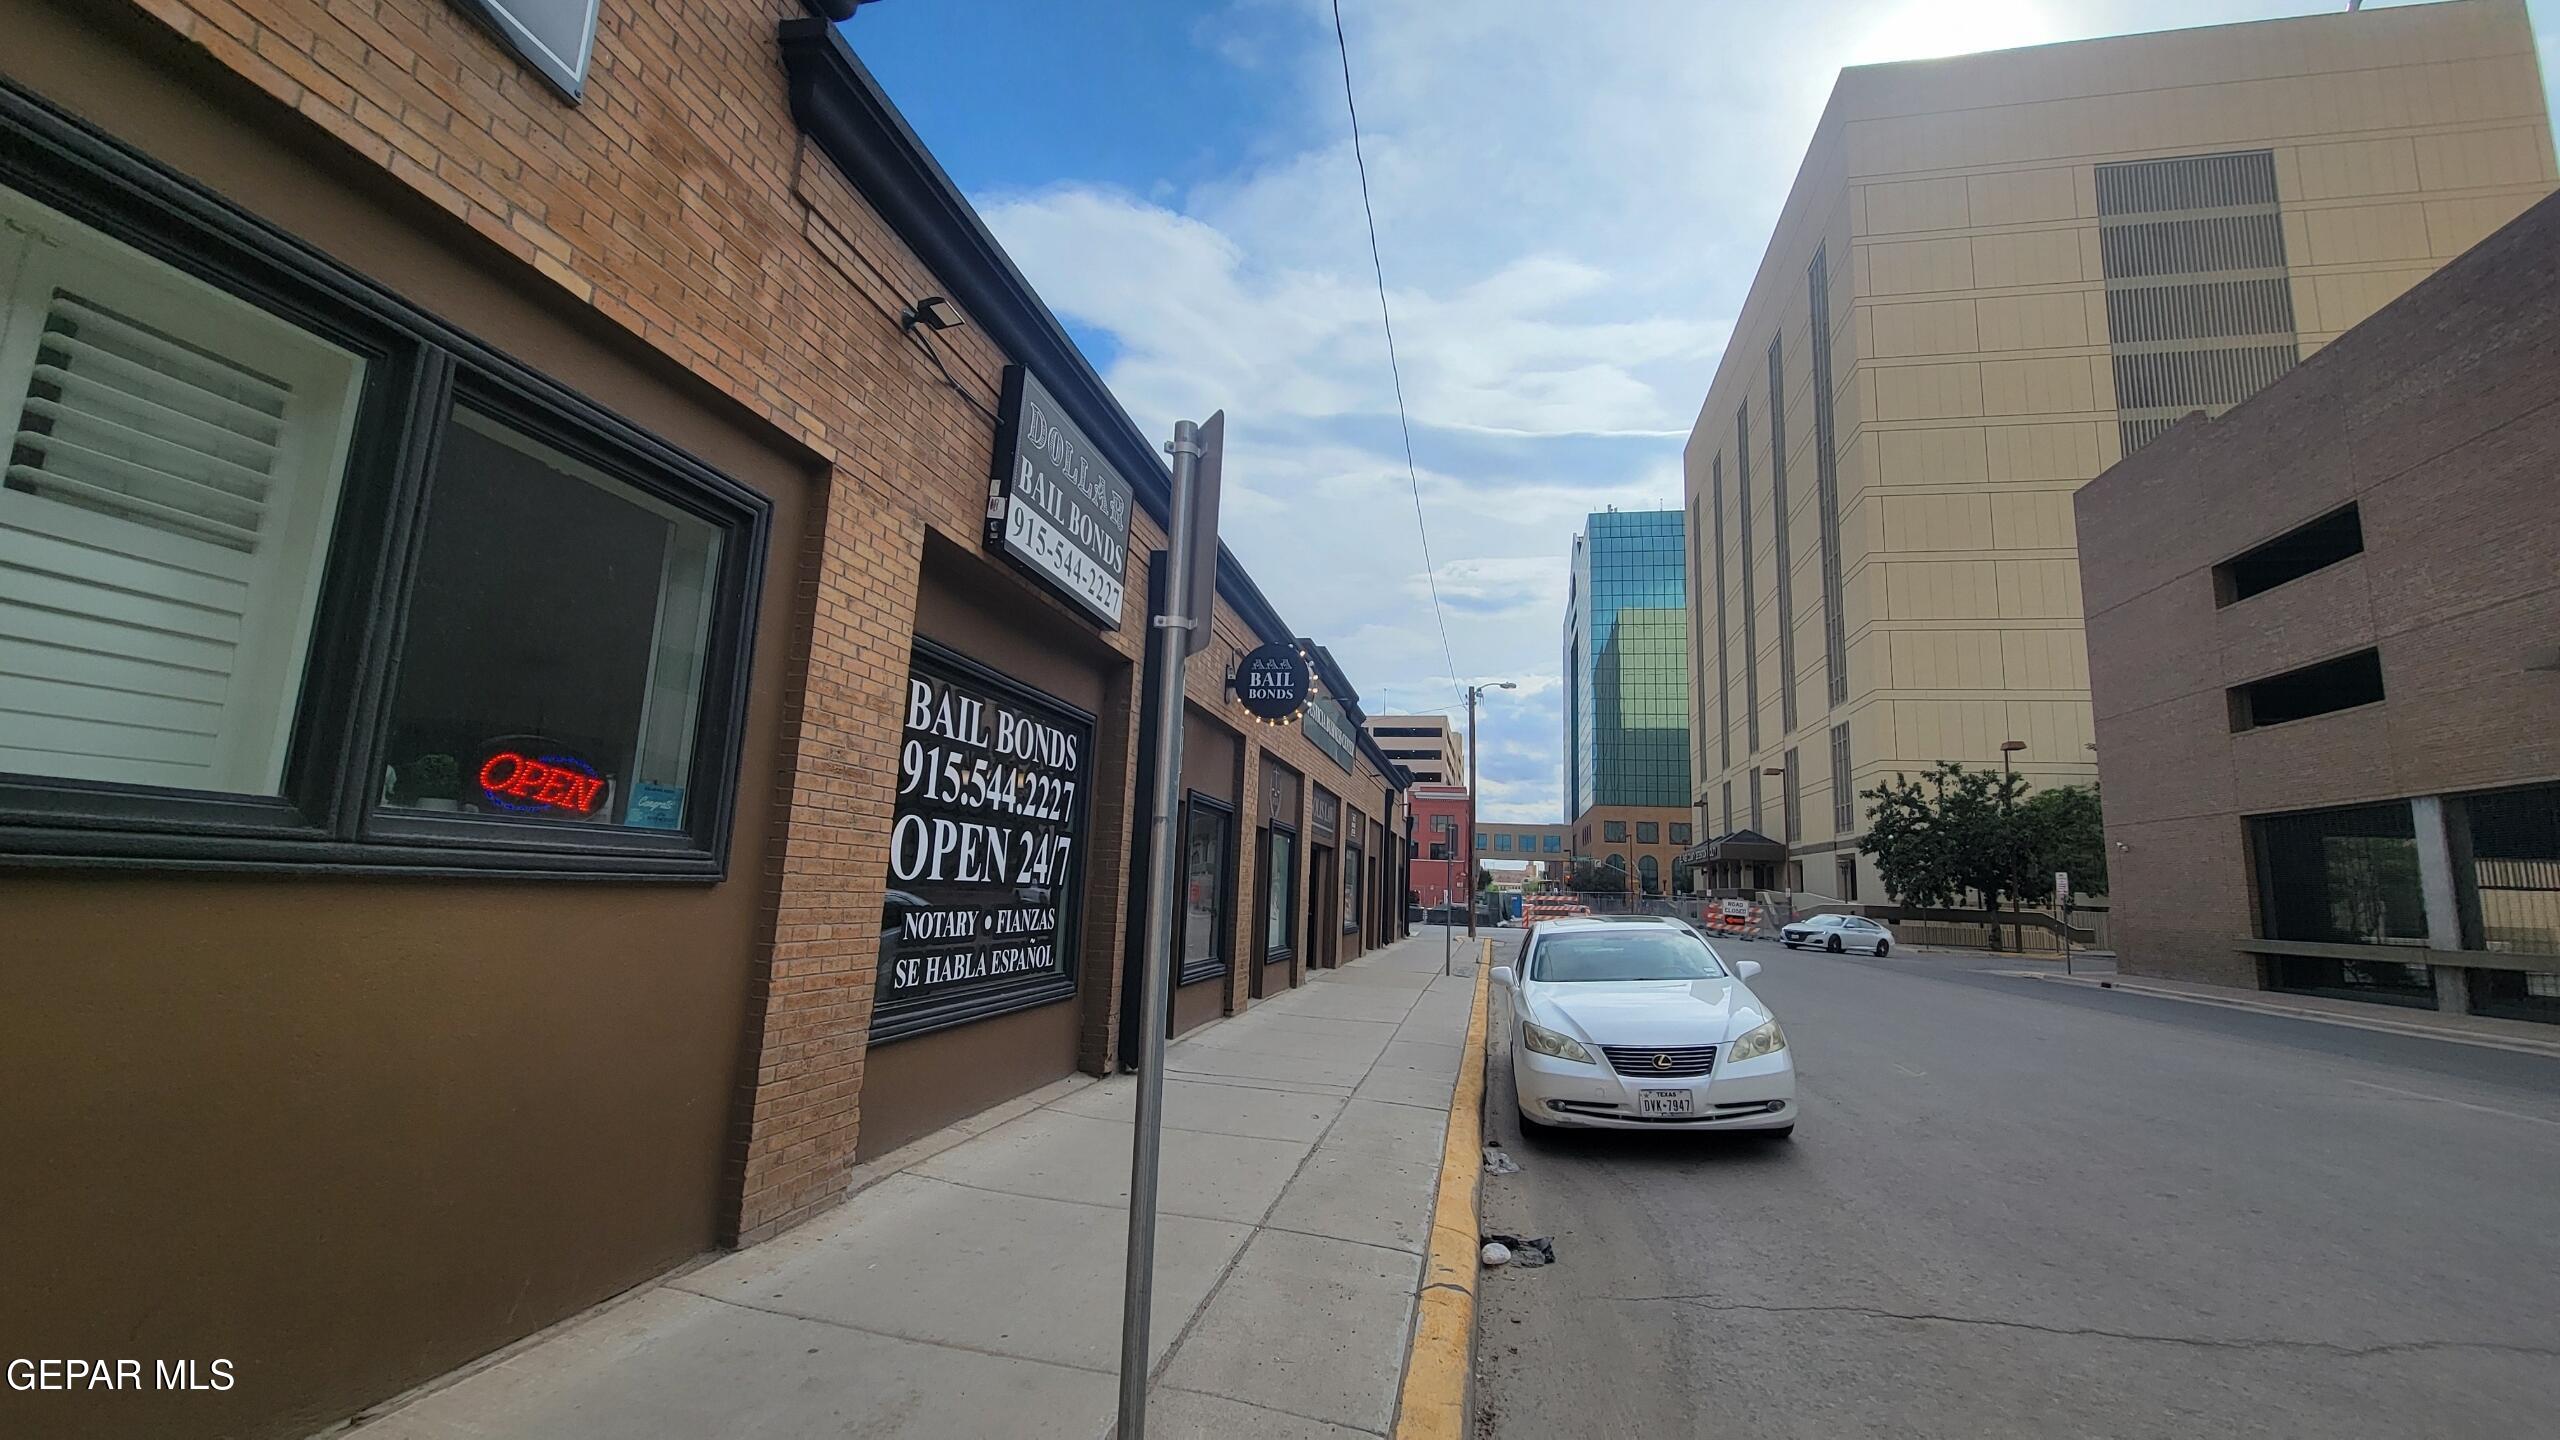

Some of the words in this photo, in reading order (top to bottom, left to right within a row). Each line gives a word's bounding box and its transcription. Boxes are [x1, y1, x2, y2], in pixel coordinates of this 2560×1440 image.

[1028, 402, 1124, 532] DOLLAR
[1018, 455, 1065, 524] BAIL
[1068, 502, 1124, 574] BONDS
[1013, 507, 1120, 614] 915-544-2227
[1248, 672, 1294, 687] BAIL
[1248, 689, 1294, 700] BONDS
[1251, 658, 1293, 670] AAA
[905, 679, 992, 748] BAIL
[995, 709, 1078, 772] BONDS
[479, 751, 605, 813] OPEN
[899, 739, 1075, 822] 915.544.2227
[891, 814, 1012, 884] OPEN
[1016, 833, 1071, 887] 24/7
[903, 910, 979, 940] NOTARY
[995, 908, 1055, 934] FIANZAS
[894, 958, 921, 989] SE
[924, 952, 988, 985] HABLA
[989, 939, 1054, 975] ESPAÑOL
